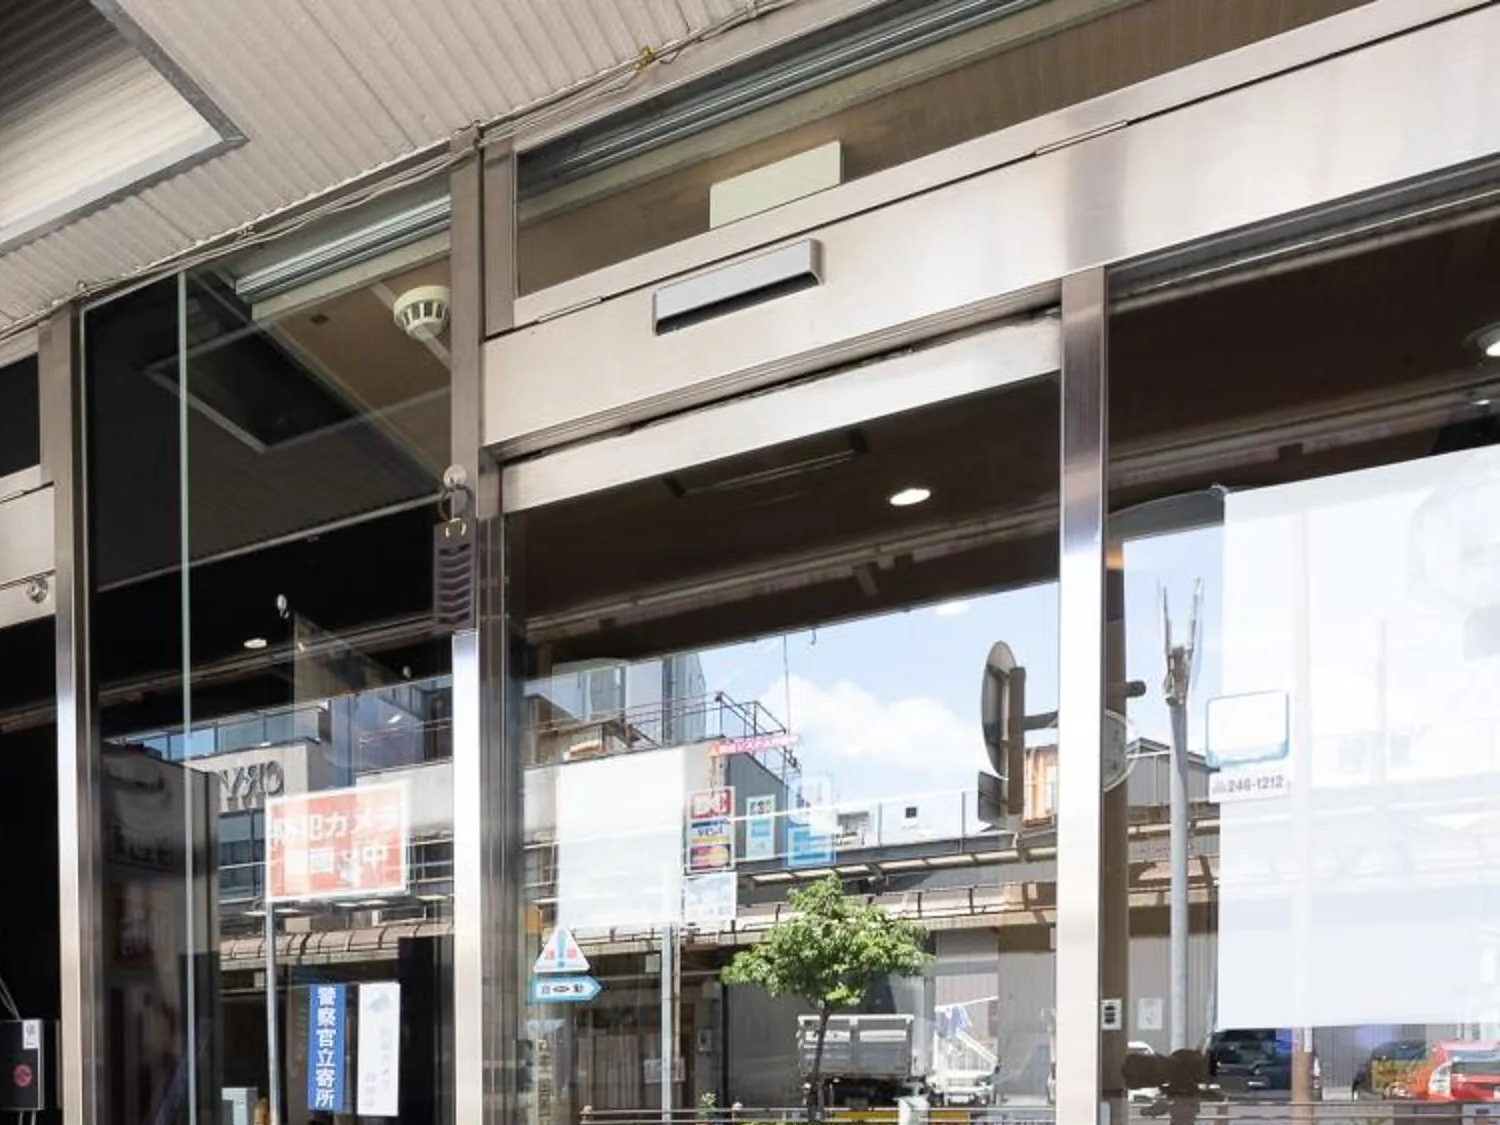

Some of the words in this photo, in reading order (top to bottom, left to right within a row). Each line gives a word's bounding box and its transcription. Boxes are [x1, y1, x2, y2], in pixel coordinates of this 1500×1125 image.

[315, 986, 337, 1109] 警察官立寄所
